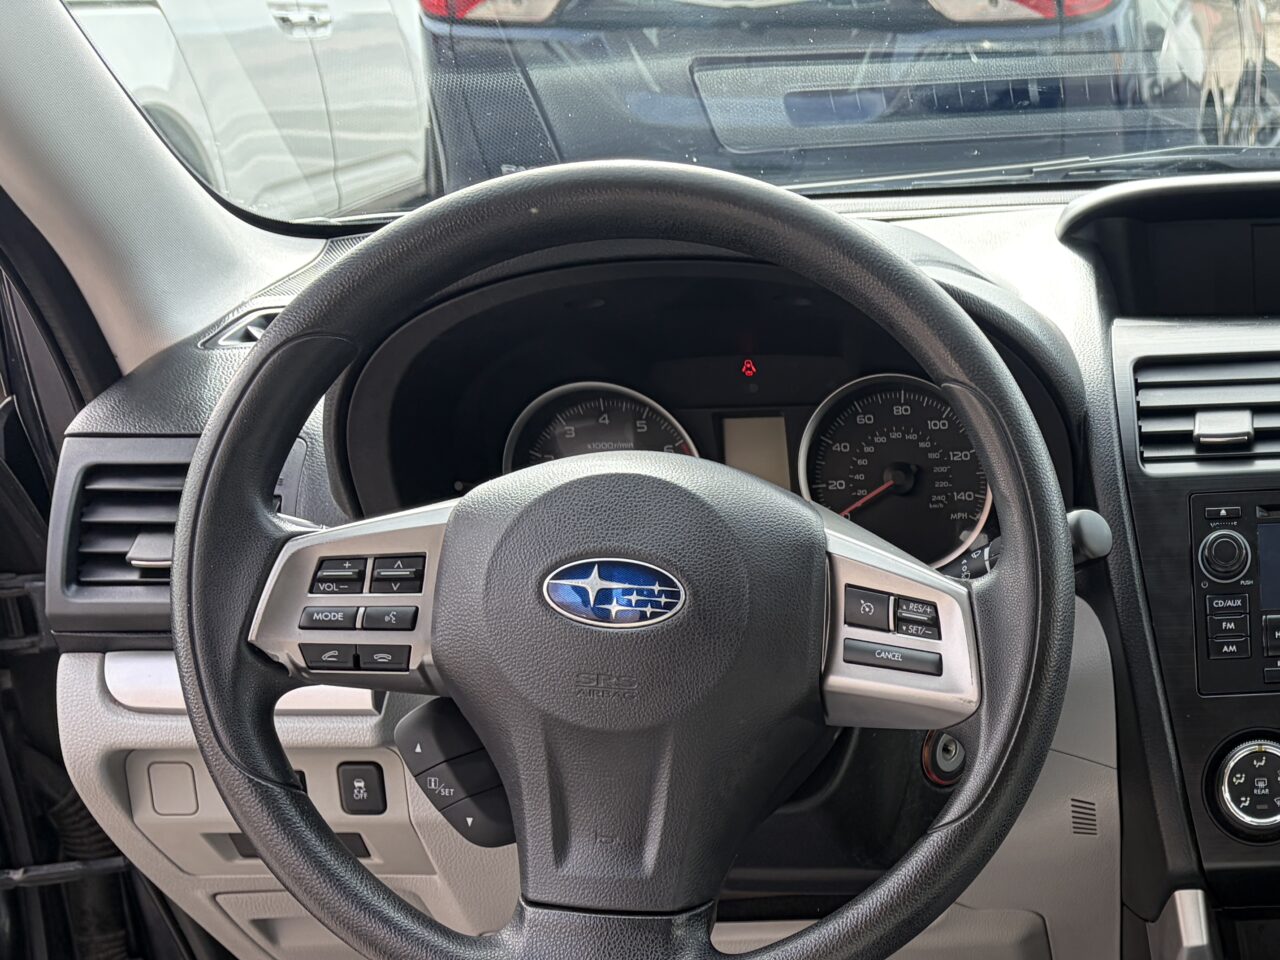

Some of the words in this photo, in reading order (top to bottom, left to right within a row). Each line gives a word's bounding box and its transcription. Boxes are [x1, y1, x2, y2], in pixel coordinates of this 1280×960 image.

[893, 405, 911, 416] 80
[598, 413, 610, 425] 4
[856, 414, 874, 424] 60
[636, 421, 648, 433] 5
[927, 420, 949, 430] 100
[564, 426, 575, 438] 3
[832, 442, 850, 452] 40
[949, 451, 971, 461] 120
[828, 480, 846, 490] 20
[953, 491, 974, 501] 140
[950, 512, 968, 520] MPH
[1213, 599, 1242, 608] CD/AUX
[313, 612, 344, 621] MODE
[1222, 622, 1236, 630] FM
[1222, 645, 1237, 653] AM
[875, 650, 903, 662] CANCEL
[1253, 788, 1270, 796] REAR
